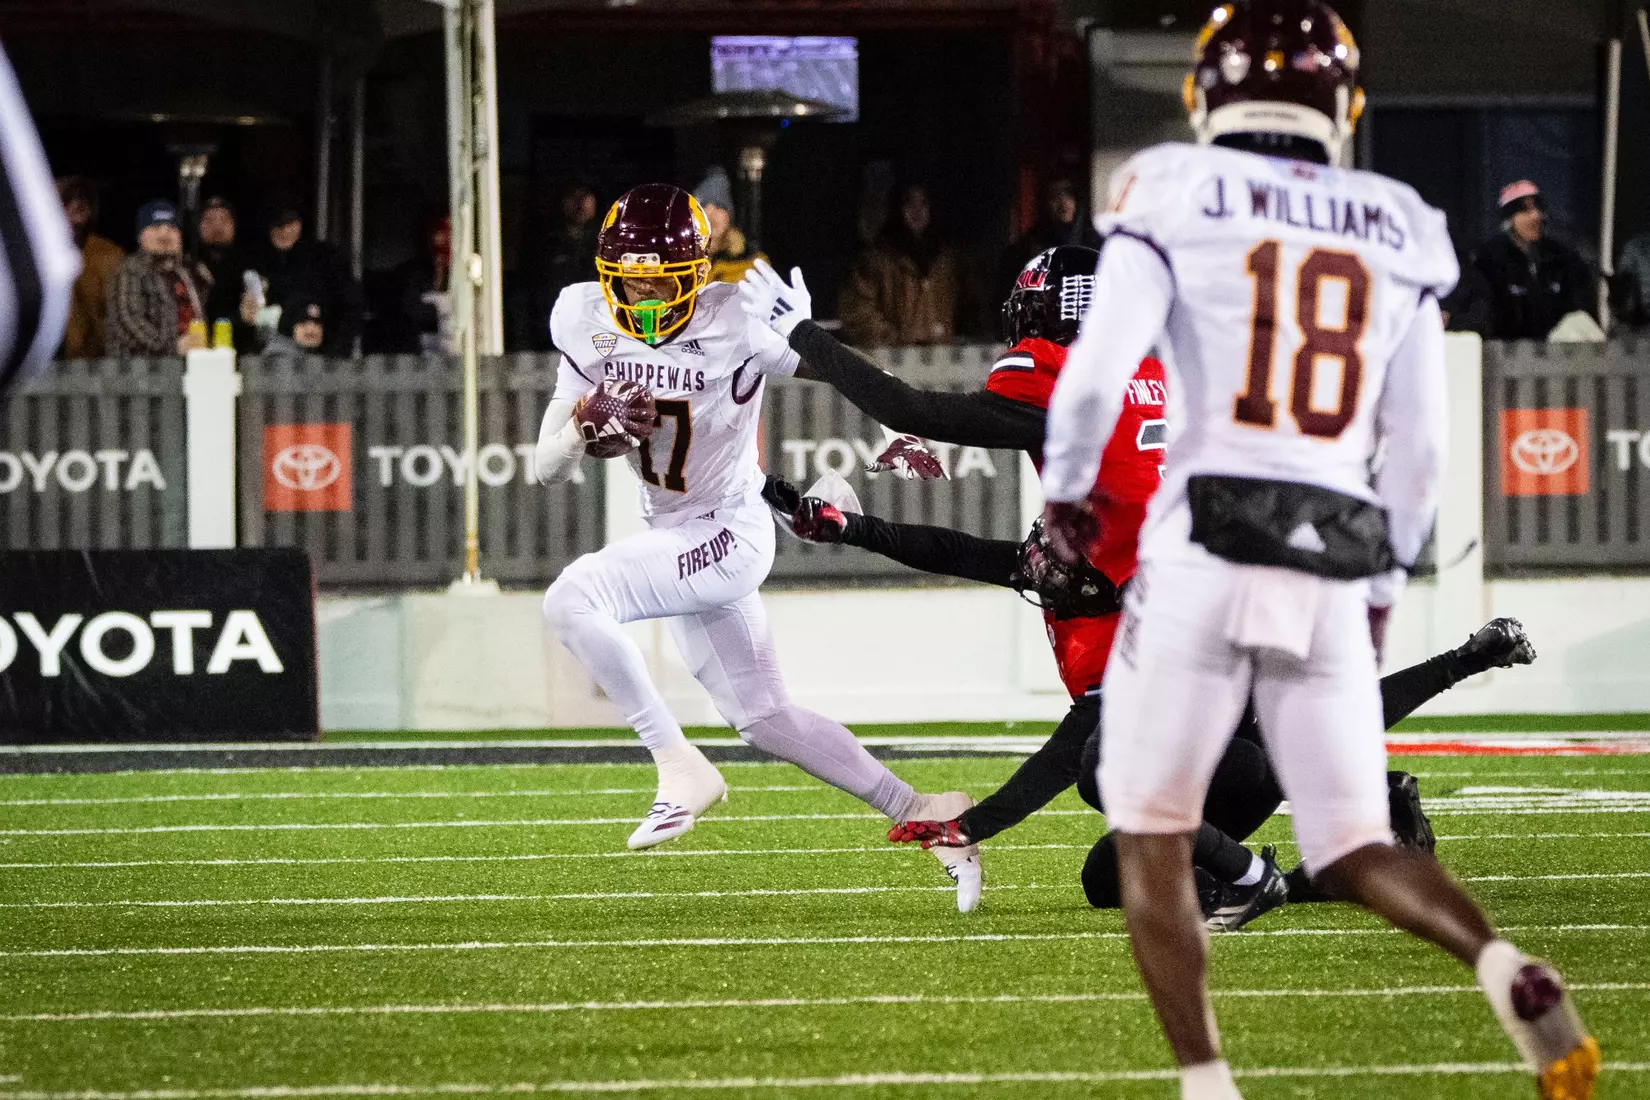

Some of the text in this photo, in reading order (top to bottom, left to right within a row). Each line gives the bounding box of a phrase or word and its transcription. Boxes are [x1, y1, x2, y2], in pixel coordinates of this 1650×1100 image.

[1246, 178, 1404, 251] WILLIAMS
[1232, 238, 1372, 441] 18
[604, 361, 705, 393] CHIPPEWAS
[1127, 379, 1169, 406] FINLEY
[368, 443, 585, 487] TOYOT
[780, 438, 997, 482] TOYTA
[677, 541, 710, 580] FIRE
[0, 609, 285, 678] YOTA
